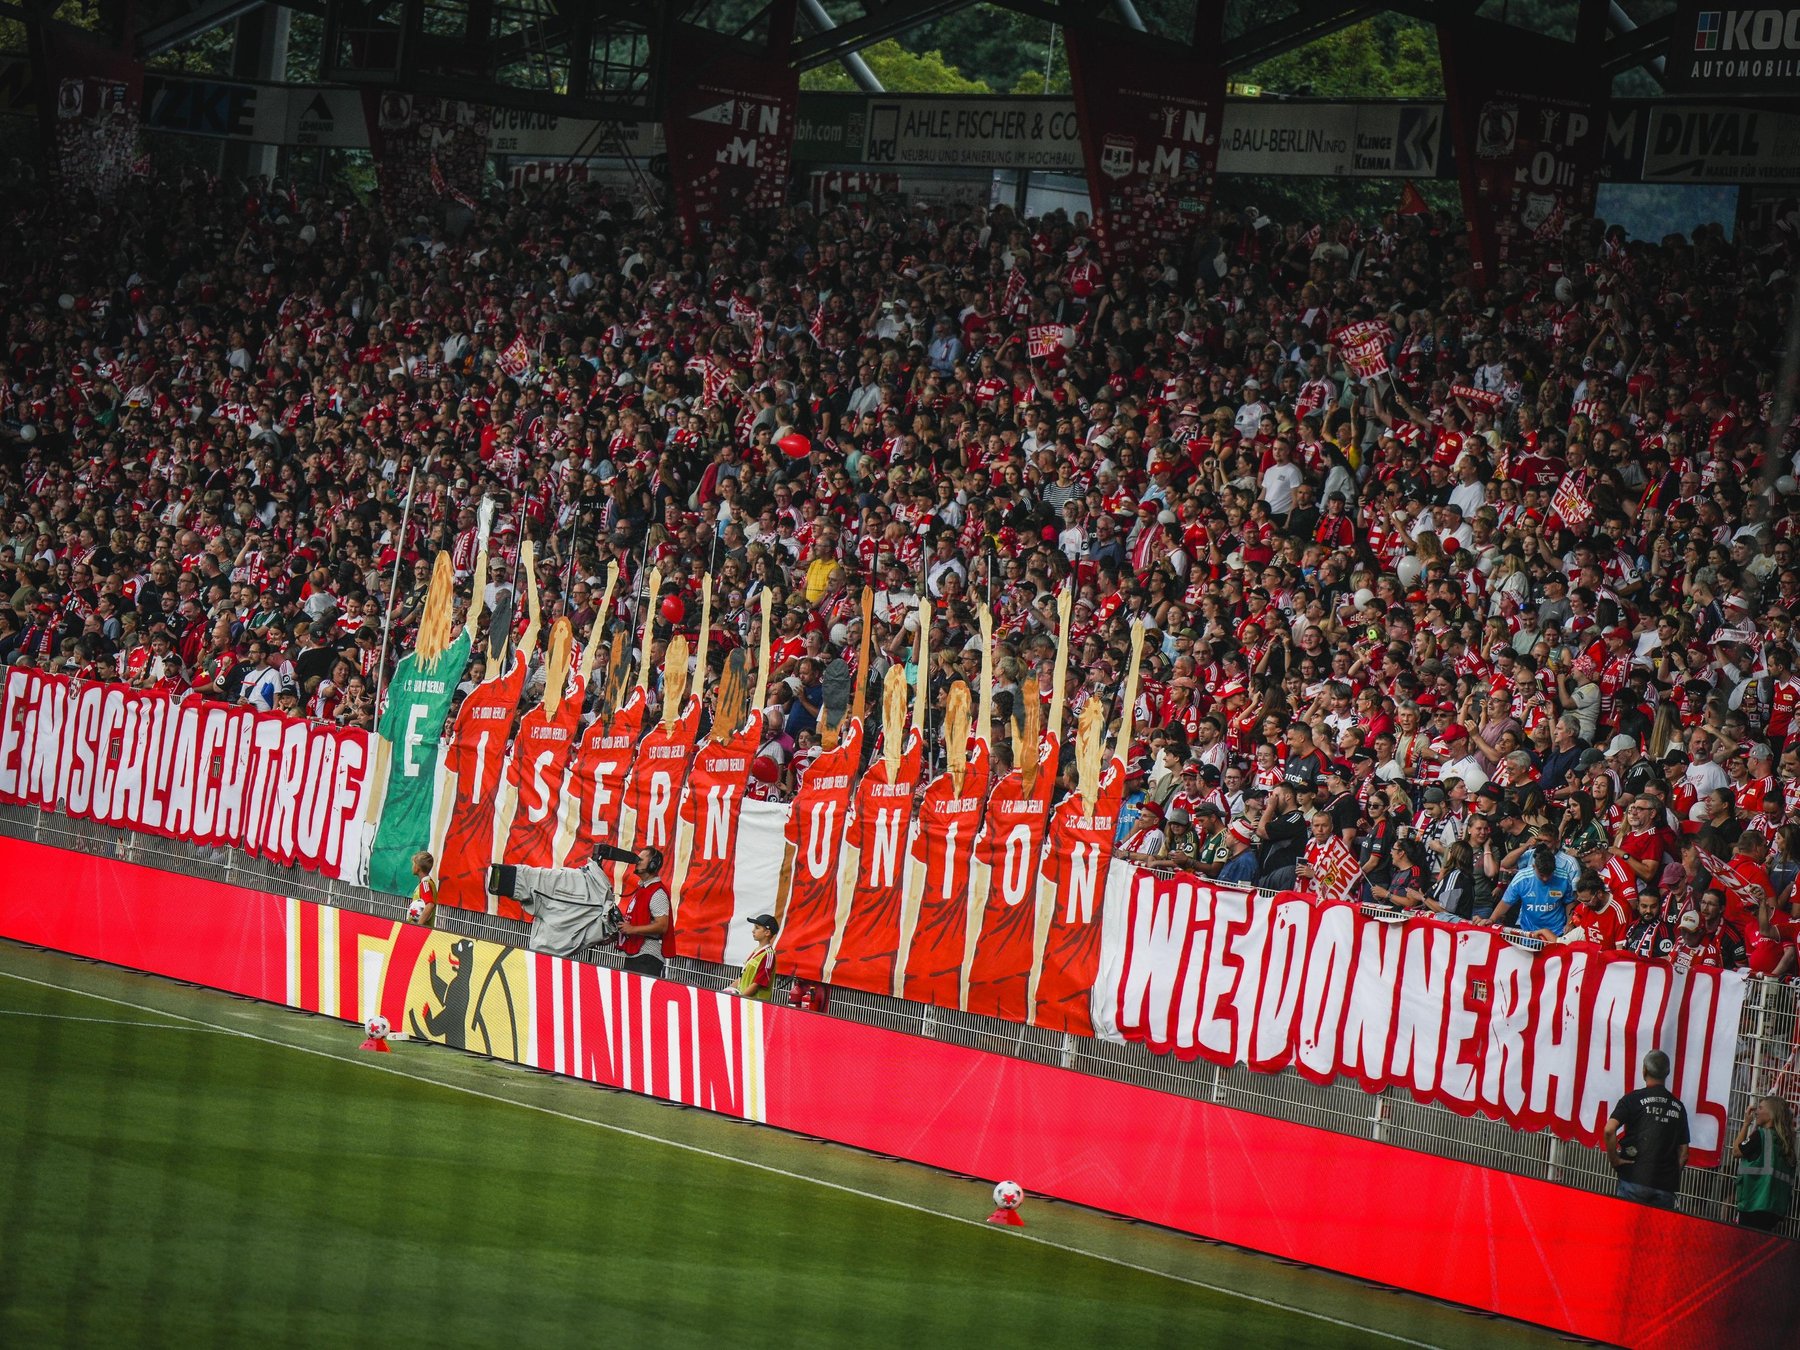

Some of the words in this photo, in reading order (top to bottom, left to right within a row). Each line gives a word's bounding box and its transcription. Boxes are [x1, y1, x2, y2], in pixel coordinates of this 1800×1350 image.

[901, 149, 935, 162] NEUBAU
[938, 150, 957, 162] UND
[960, 150, 1012, 163] SANIERUNG
[1015, 152, 1026, 163] IM
[1028, 151, 1075, 165] HOCHBAU
[903, 110, 952, 141] AHLE,
[956, 110, 1026, 139] FISCHER
[1031, 112, 1043, 139] &
[1354, 154, 1391, 170] KEMNA
[1356, 133, 1392, 150] KLINGE
[1654, 112, 1760, 156] DIVAL
[404, 703, 429, 777] E
[472, 731, 490, 804] I
[528, 750, 555, 823] S
[591, 761, 618, 836] E
[646, 771, 671, 847] R
[703, 784, 736, 861] N
[807, 800, 837, 880] U
[870, 808, 902, 888] N
[942, 821, 959, 899] I
[1003, 824, 1032, 906] O
[1066, 842, 1101, 924] N
